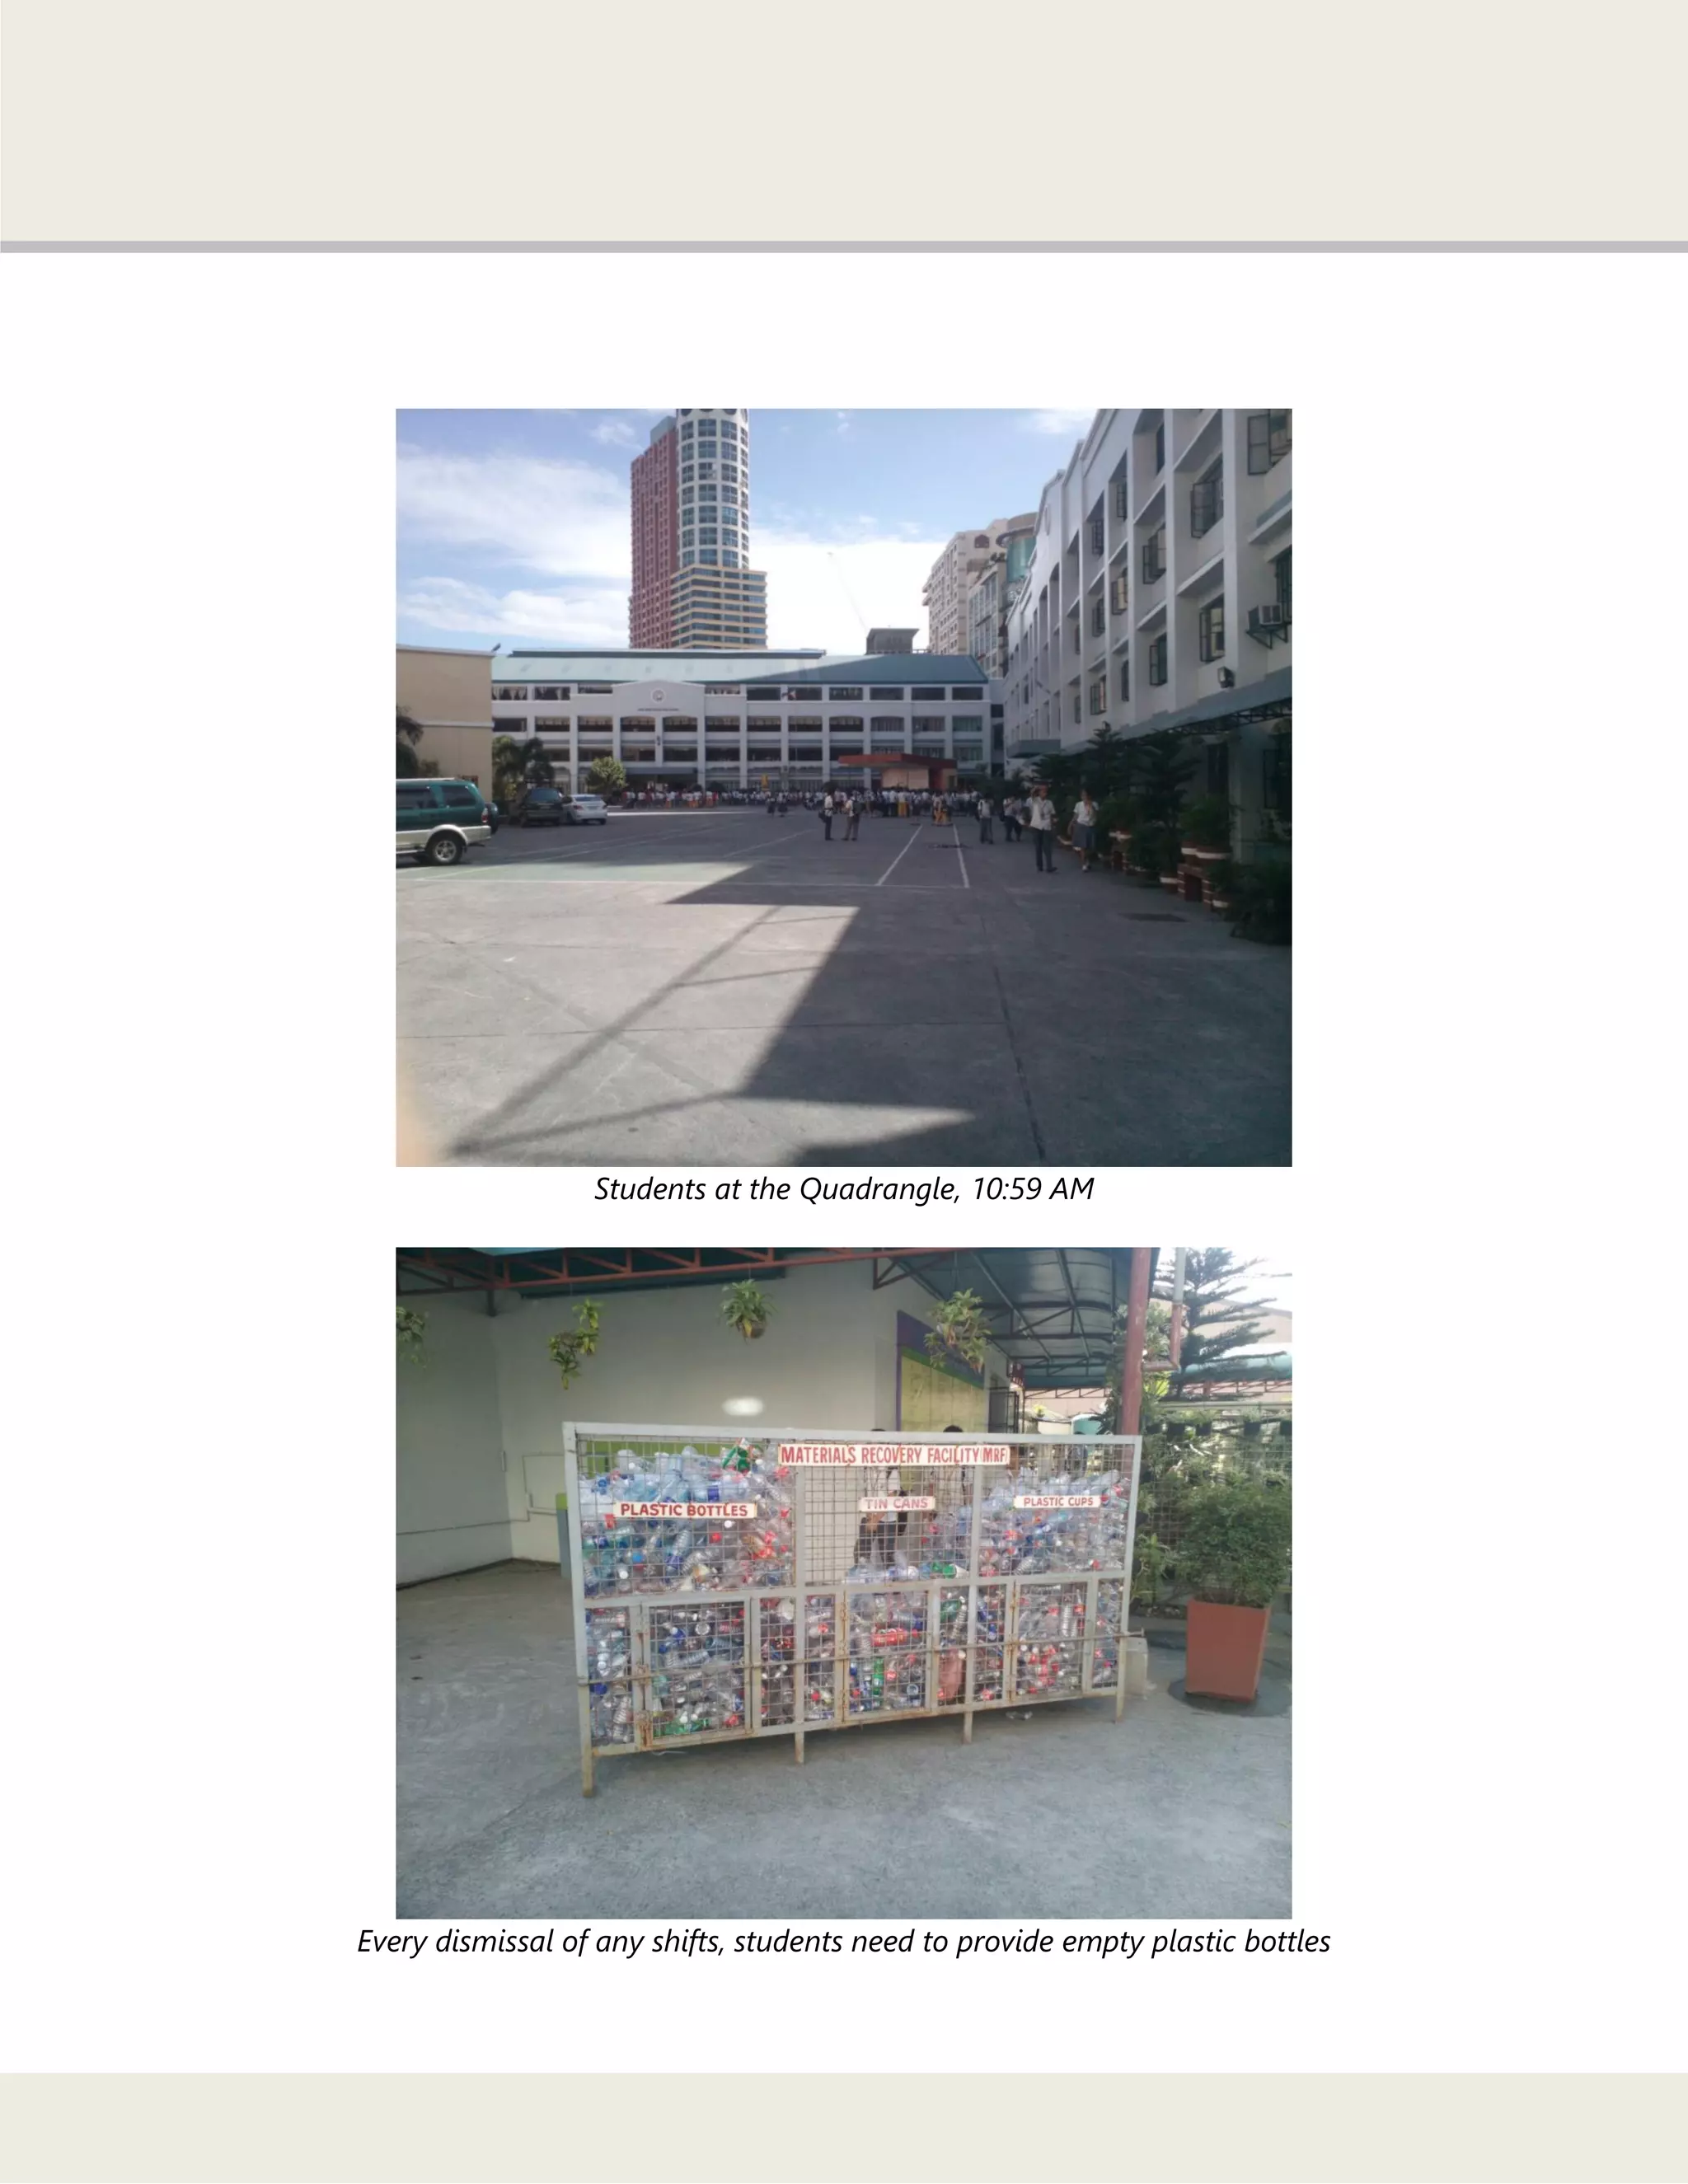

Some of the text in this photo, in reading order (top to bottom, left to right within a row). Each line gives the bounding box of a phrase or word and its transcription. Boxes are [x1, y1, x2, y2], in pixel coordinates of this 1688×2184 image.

[781, 1446, 856, 1464] MATERIALS
[861, 1446, 921, 1464] RECOVERY
[865, 1497, 929, 1510] TIN CANS
[1023, 1496, 1095, 1507] PLASTIC CUPS
[620, 1502, 748, 1517] PLASTIC BOTTLES
